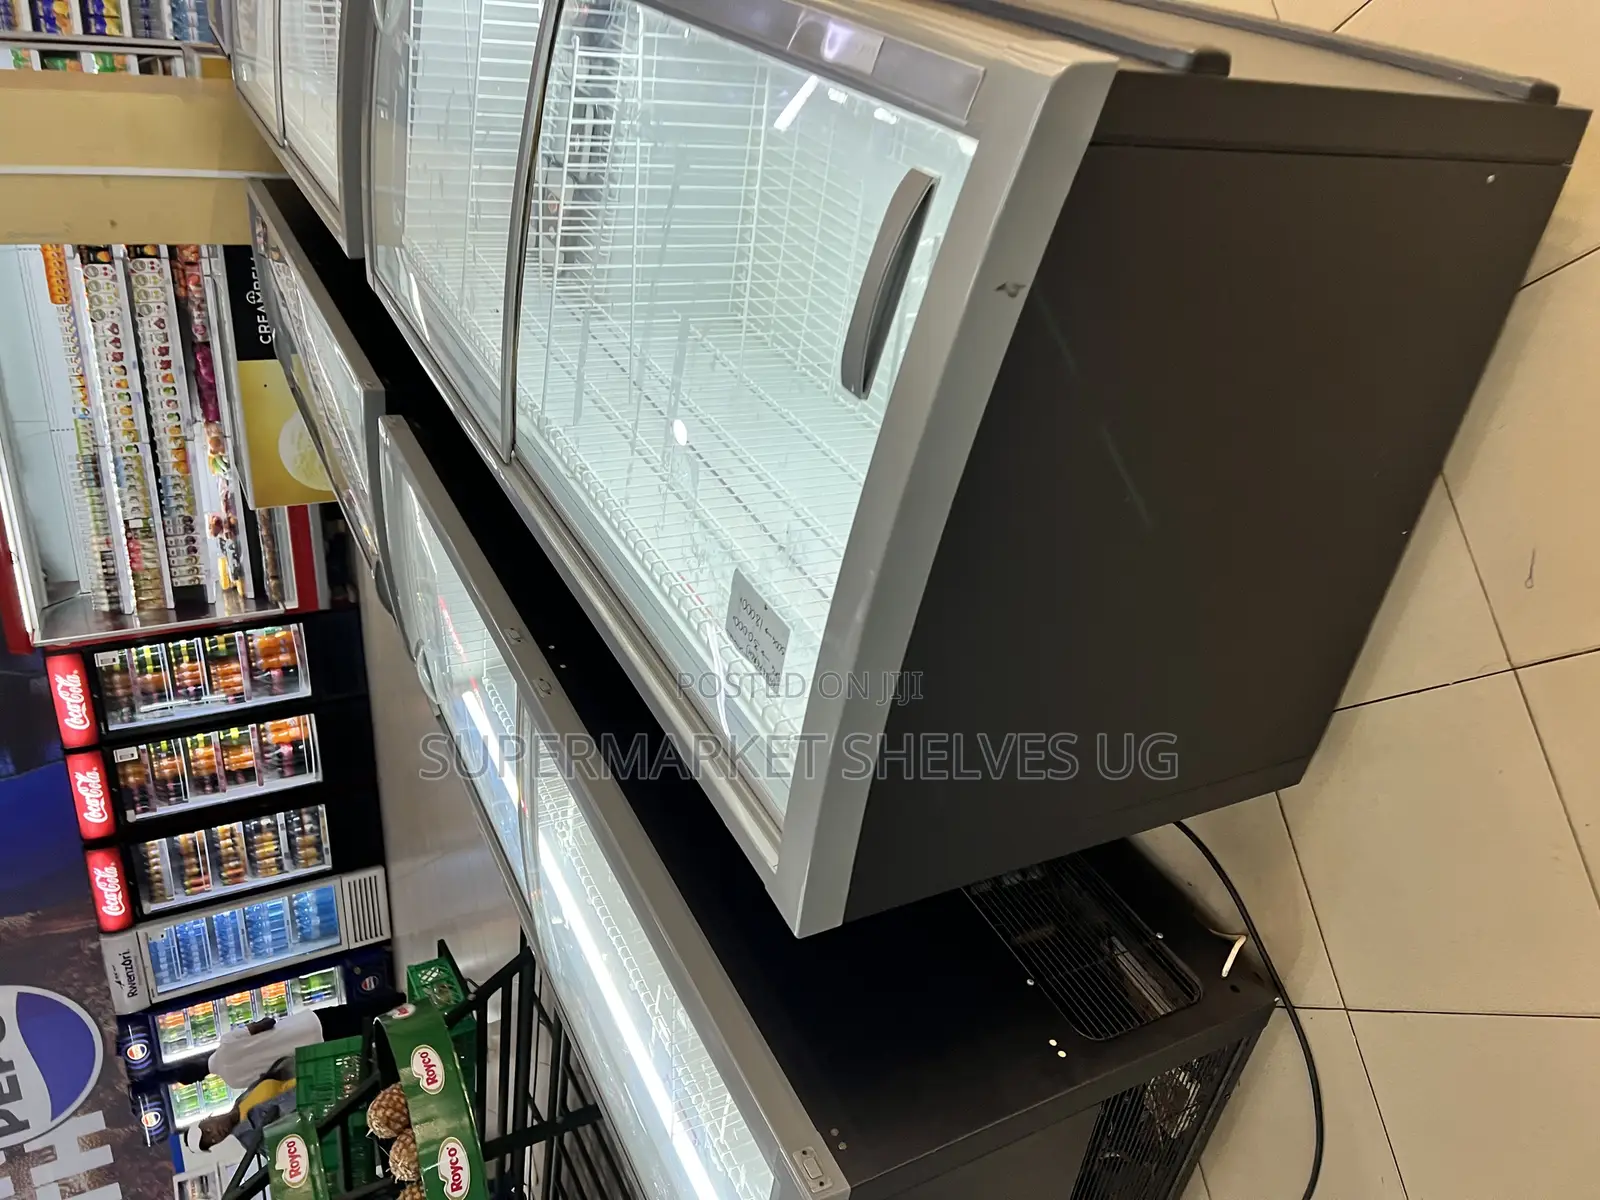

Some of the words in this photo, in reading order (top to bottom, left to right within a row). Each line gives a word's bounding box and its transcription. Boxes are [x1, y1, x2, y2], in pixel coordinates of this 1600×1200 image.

[118, 950, 138, 998] Rwenzori
[419, 1051, 438, 1086] Royco
[287, 1140, 303, 1179] Royco
[448, 1147, 463, 1193] Royco
